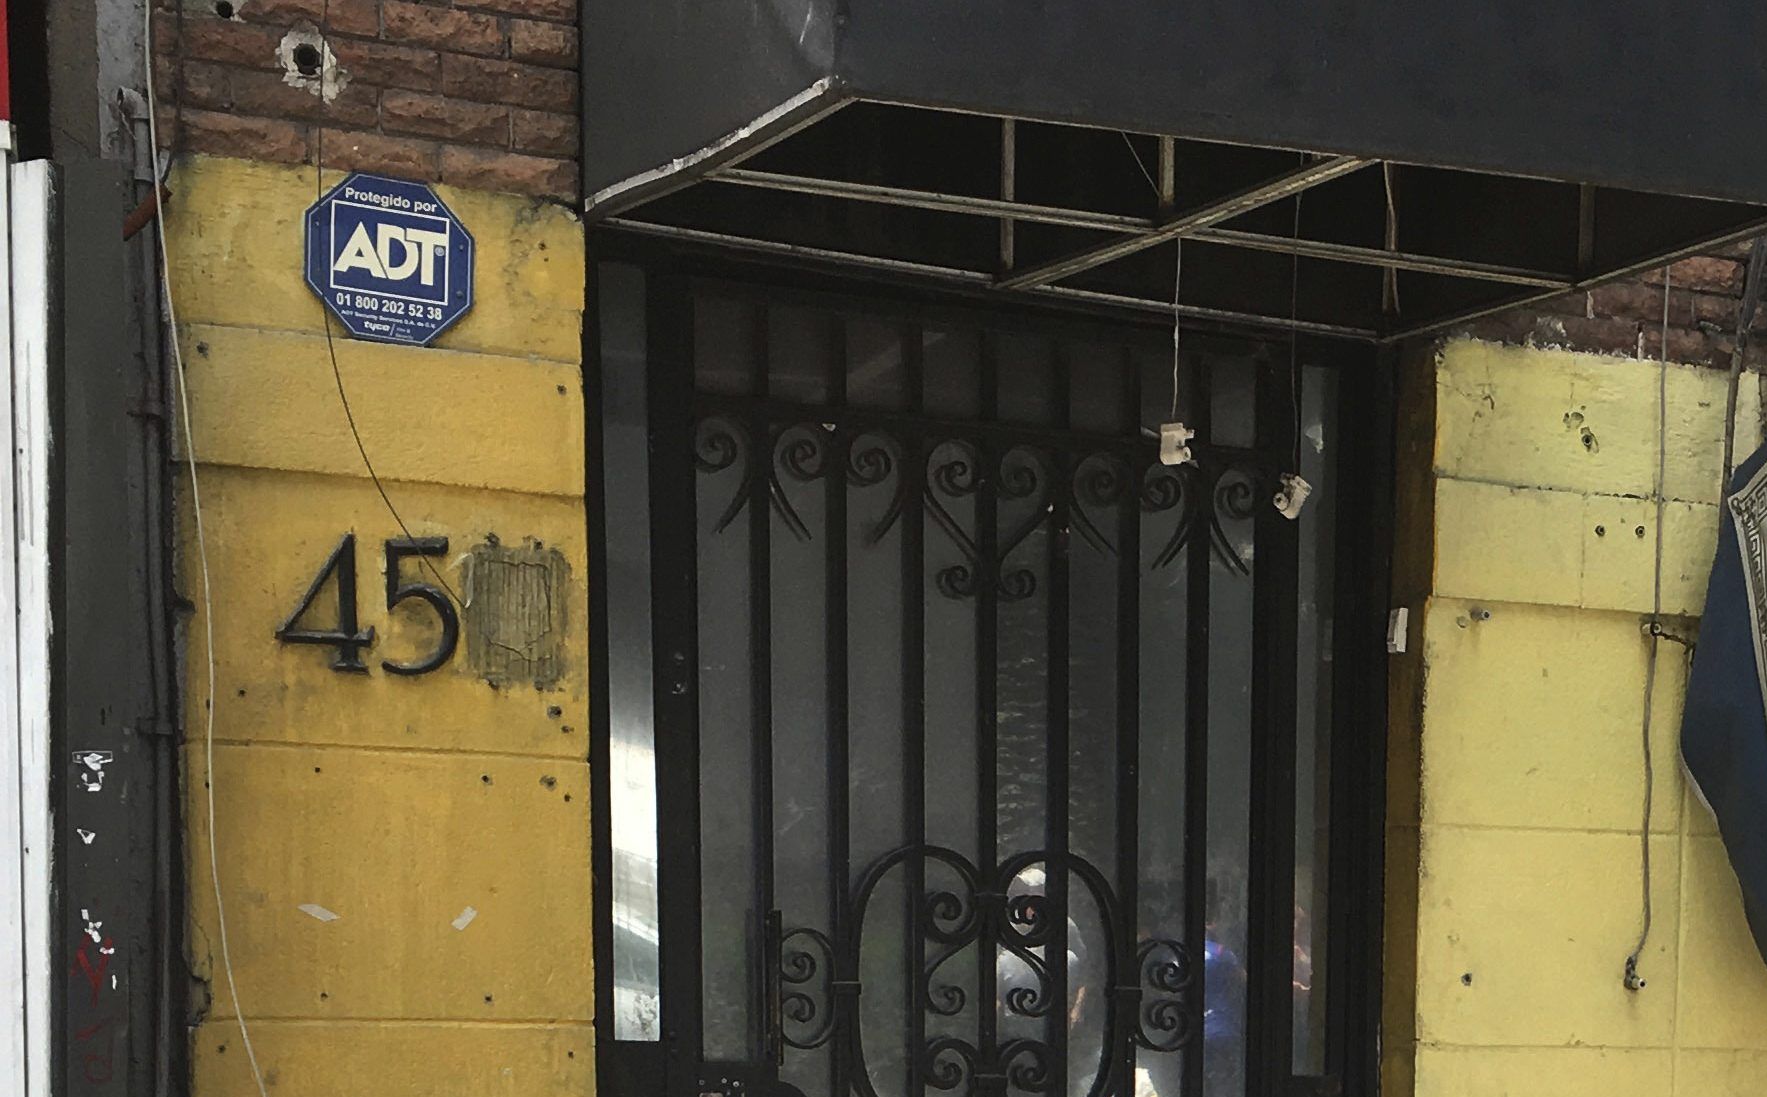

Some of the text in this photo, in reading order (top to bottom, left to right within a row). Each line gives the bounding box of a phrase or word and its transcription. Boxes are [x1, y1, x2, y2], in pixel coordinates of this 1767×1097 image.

[345, 187, 437, 212] Protegido por
[333, 221, 446, 286] ADT
[336, 292, 442, 321] 01 800 202 52 38
[364, 320, 390, 332] tyco
[274, 531, 460, 677] 45
